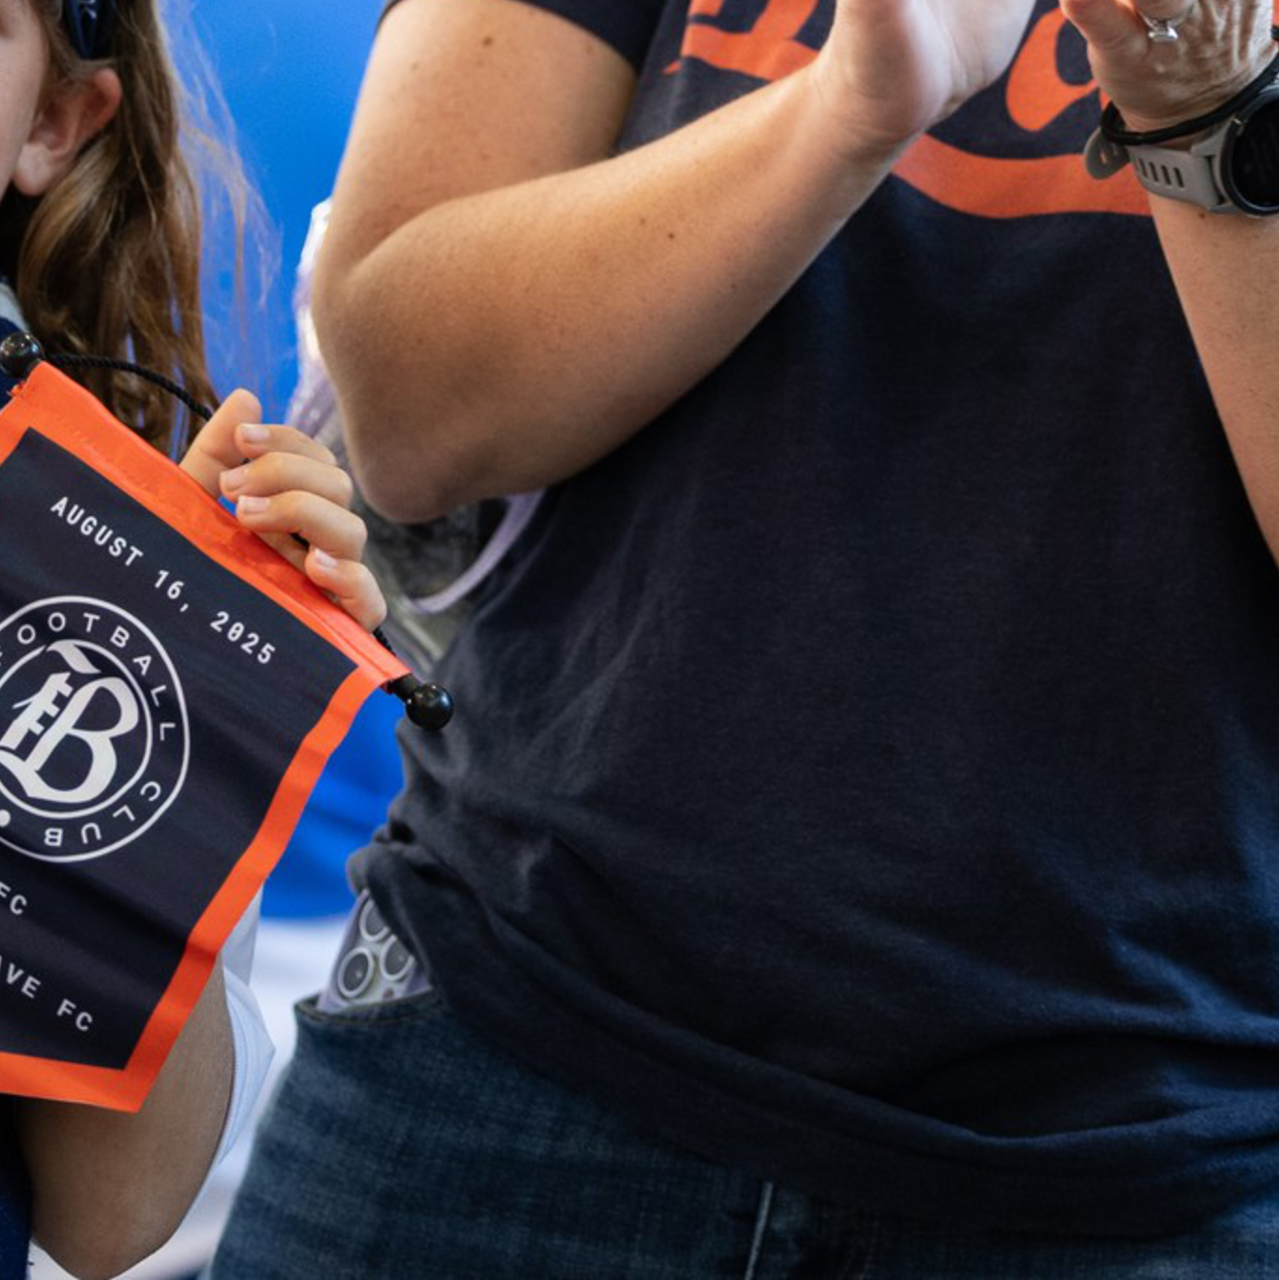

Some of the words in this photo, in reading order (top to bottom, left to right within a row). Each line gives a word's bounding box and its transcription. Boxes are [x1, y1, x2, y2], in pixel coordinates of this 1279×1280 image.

[50, 496, 144, 567] AUGUST
[154, 569, 190, 613] 16,
[209, 610, 277, 665] 2025
[43, 780, 162, 847] CLUB
[56, 998, 93, 1032] FC
